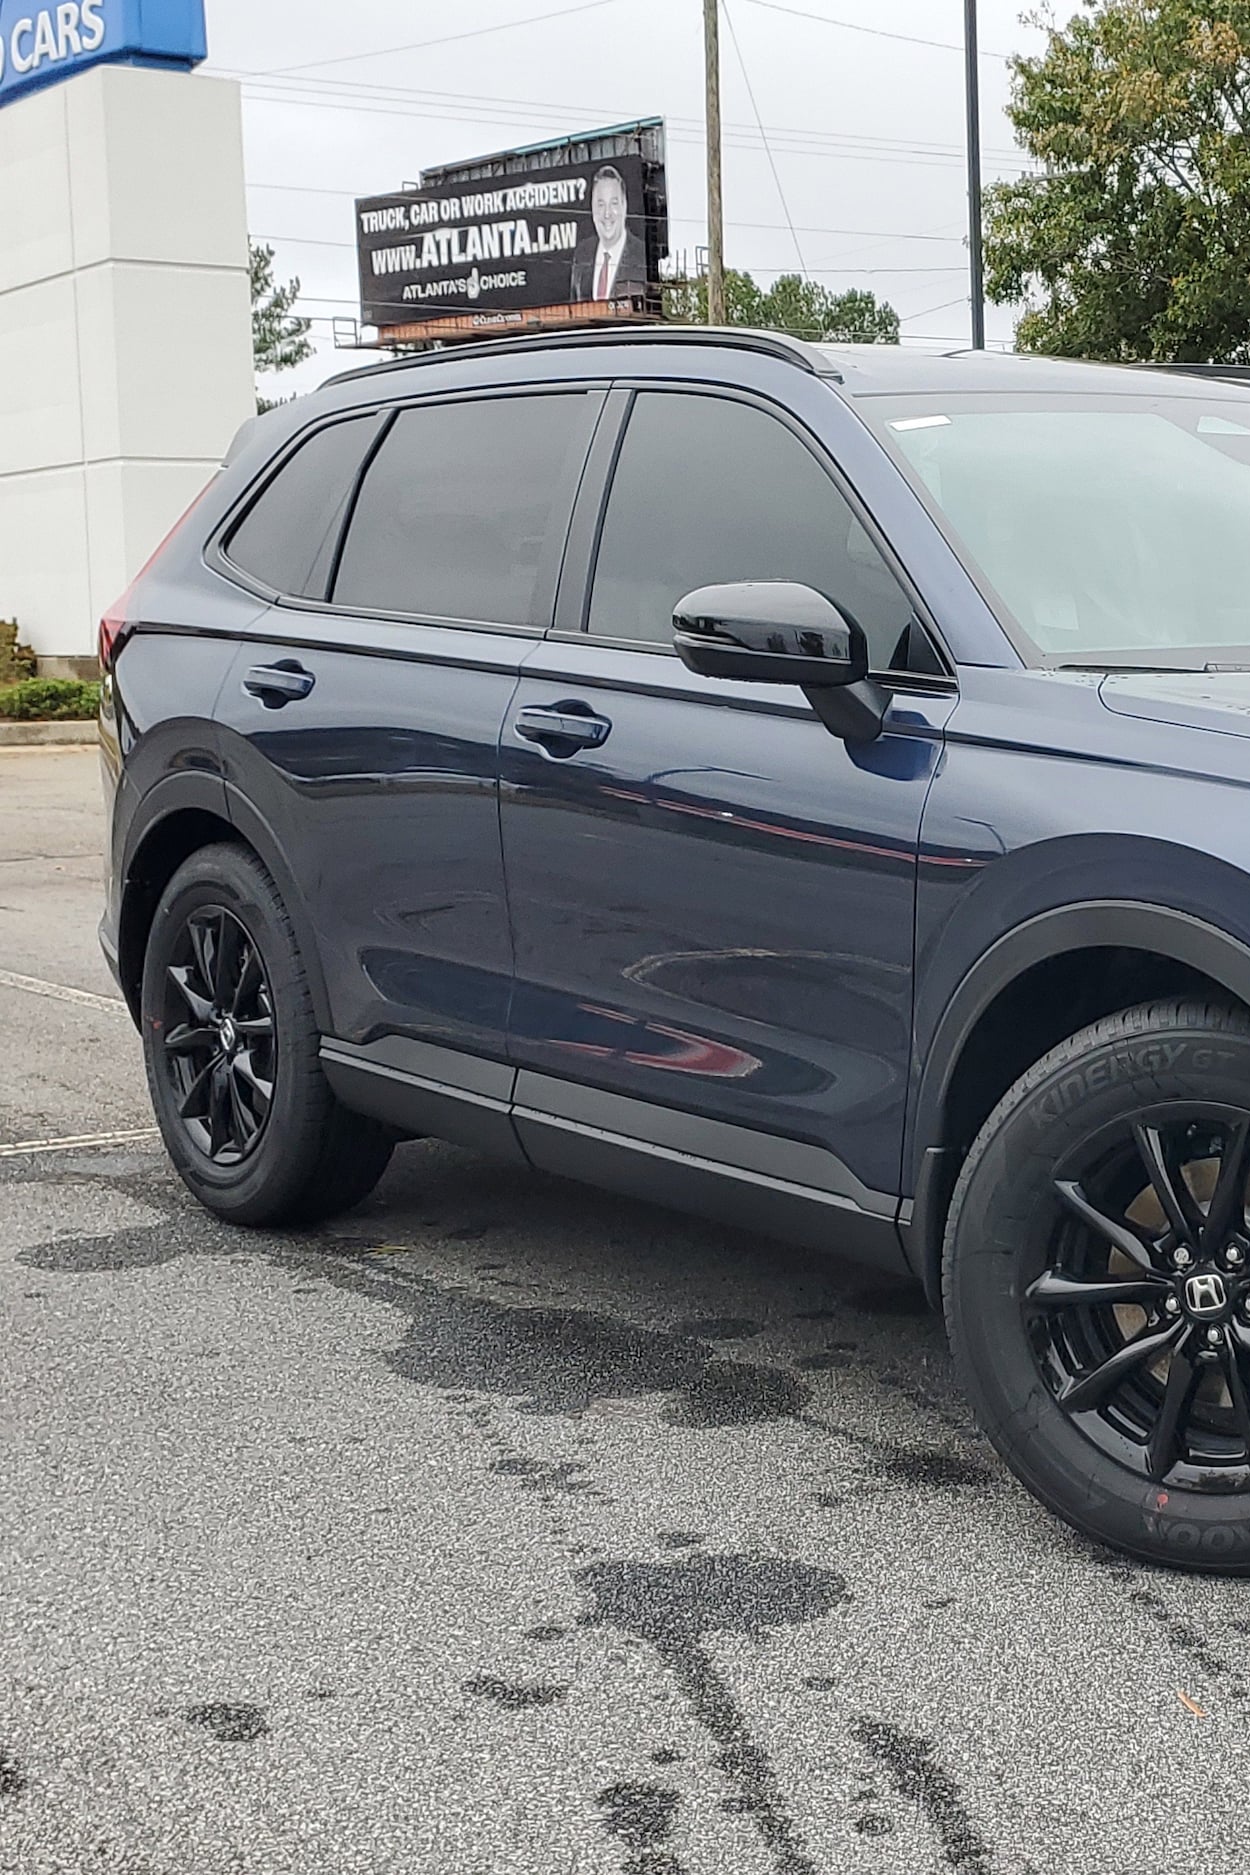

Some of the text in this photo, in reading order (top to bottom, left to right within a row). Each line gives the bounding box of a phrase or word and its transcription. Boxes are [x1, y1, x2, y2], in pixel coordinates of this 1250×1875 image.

[11, 0, 105, 73] CARS
[361, 177, 588, 234] TRUCK, CAR OR WORK ACCIDENT?
[402, 271, 527, 300] ATLANTA'S CHOICE
